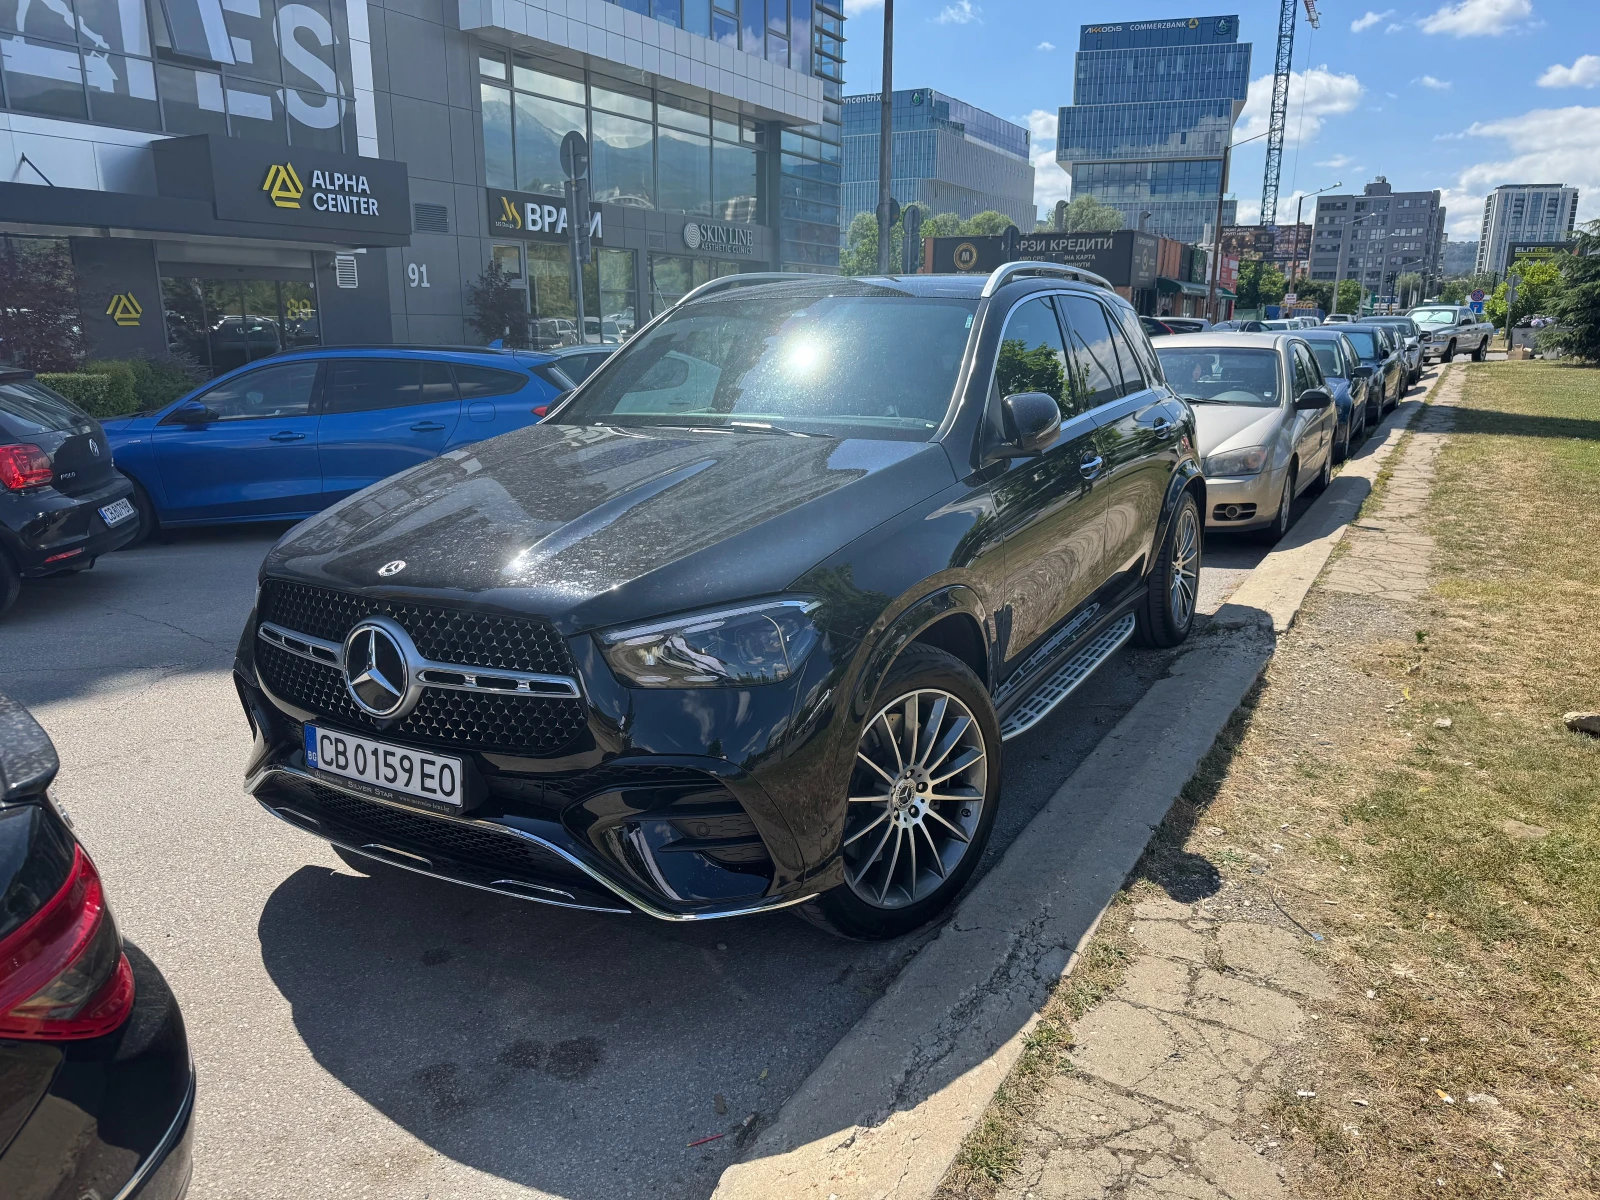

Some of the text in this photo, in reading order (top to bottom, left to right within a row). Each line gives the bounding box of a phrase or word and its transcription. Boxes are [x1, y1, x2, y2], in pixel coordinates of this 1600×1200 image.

[1129, 20, 1187, 31] COMMERZBANK
[842, 93, 882, 105] oncentrix
[311, 169, 371, 195] ALPHA
[312, 192, 380, 217] CENTER
[524, 202, 603, 239] ВРАИ
[700, 223, 754, 247] SKIN LINE
[701, 242, 753, 255] AESTHETIC CLINICS
[1049, 237, 1114, 253] КРЕДИТИ
[407, 262, 431, 288] 91
[60, 471, 76, 480] POLO
[307, 750, 317, 762] BG
[319, 734, 349, 771] CB
[347, 780, 372, 794] SILVER
[374, 788, 394, 799] STAR
